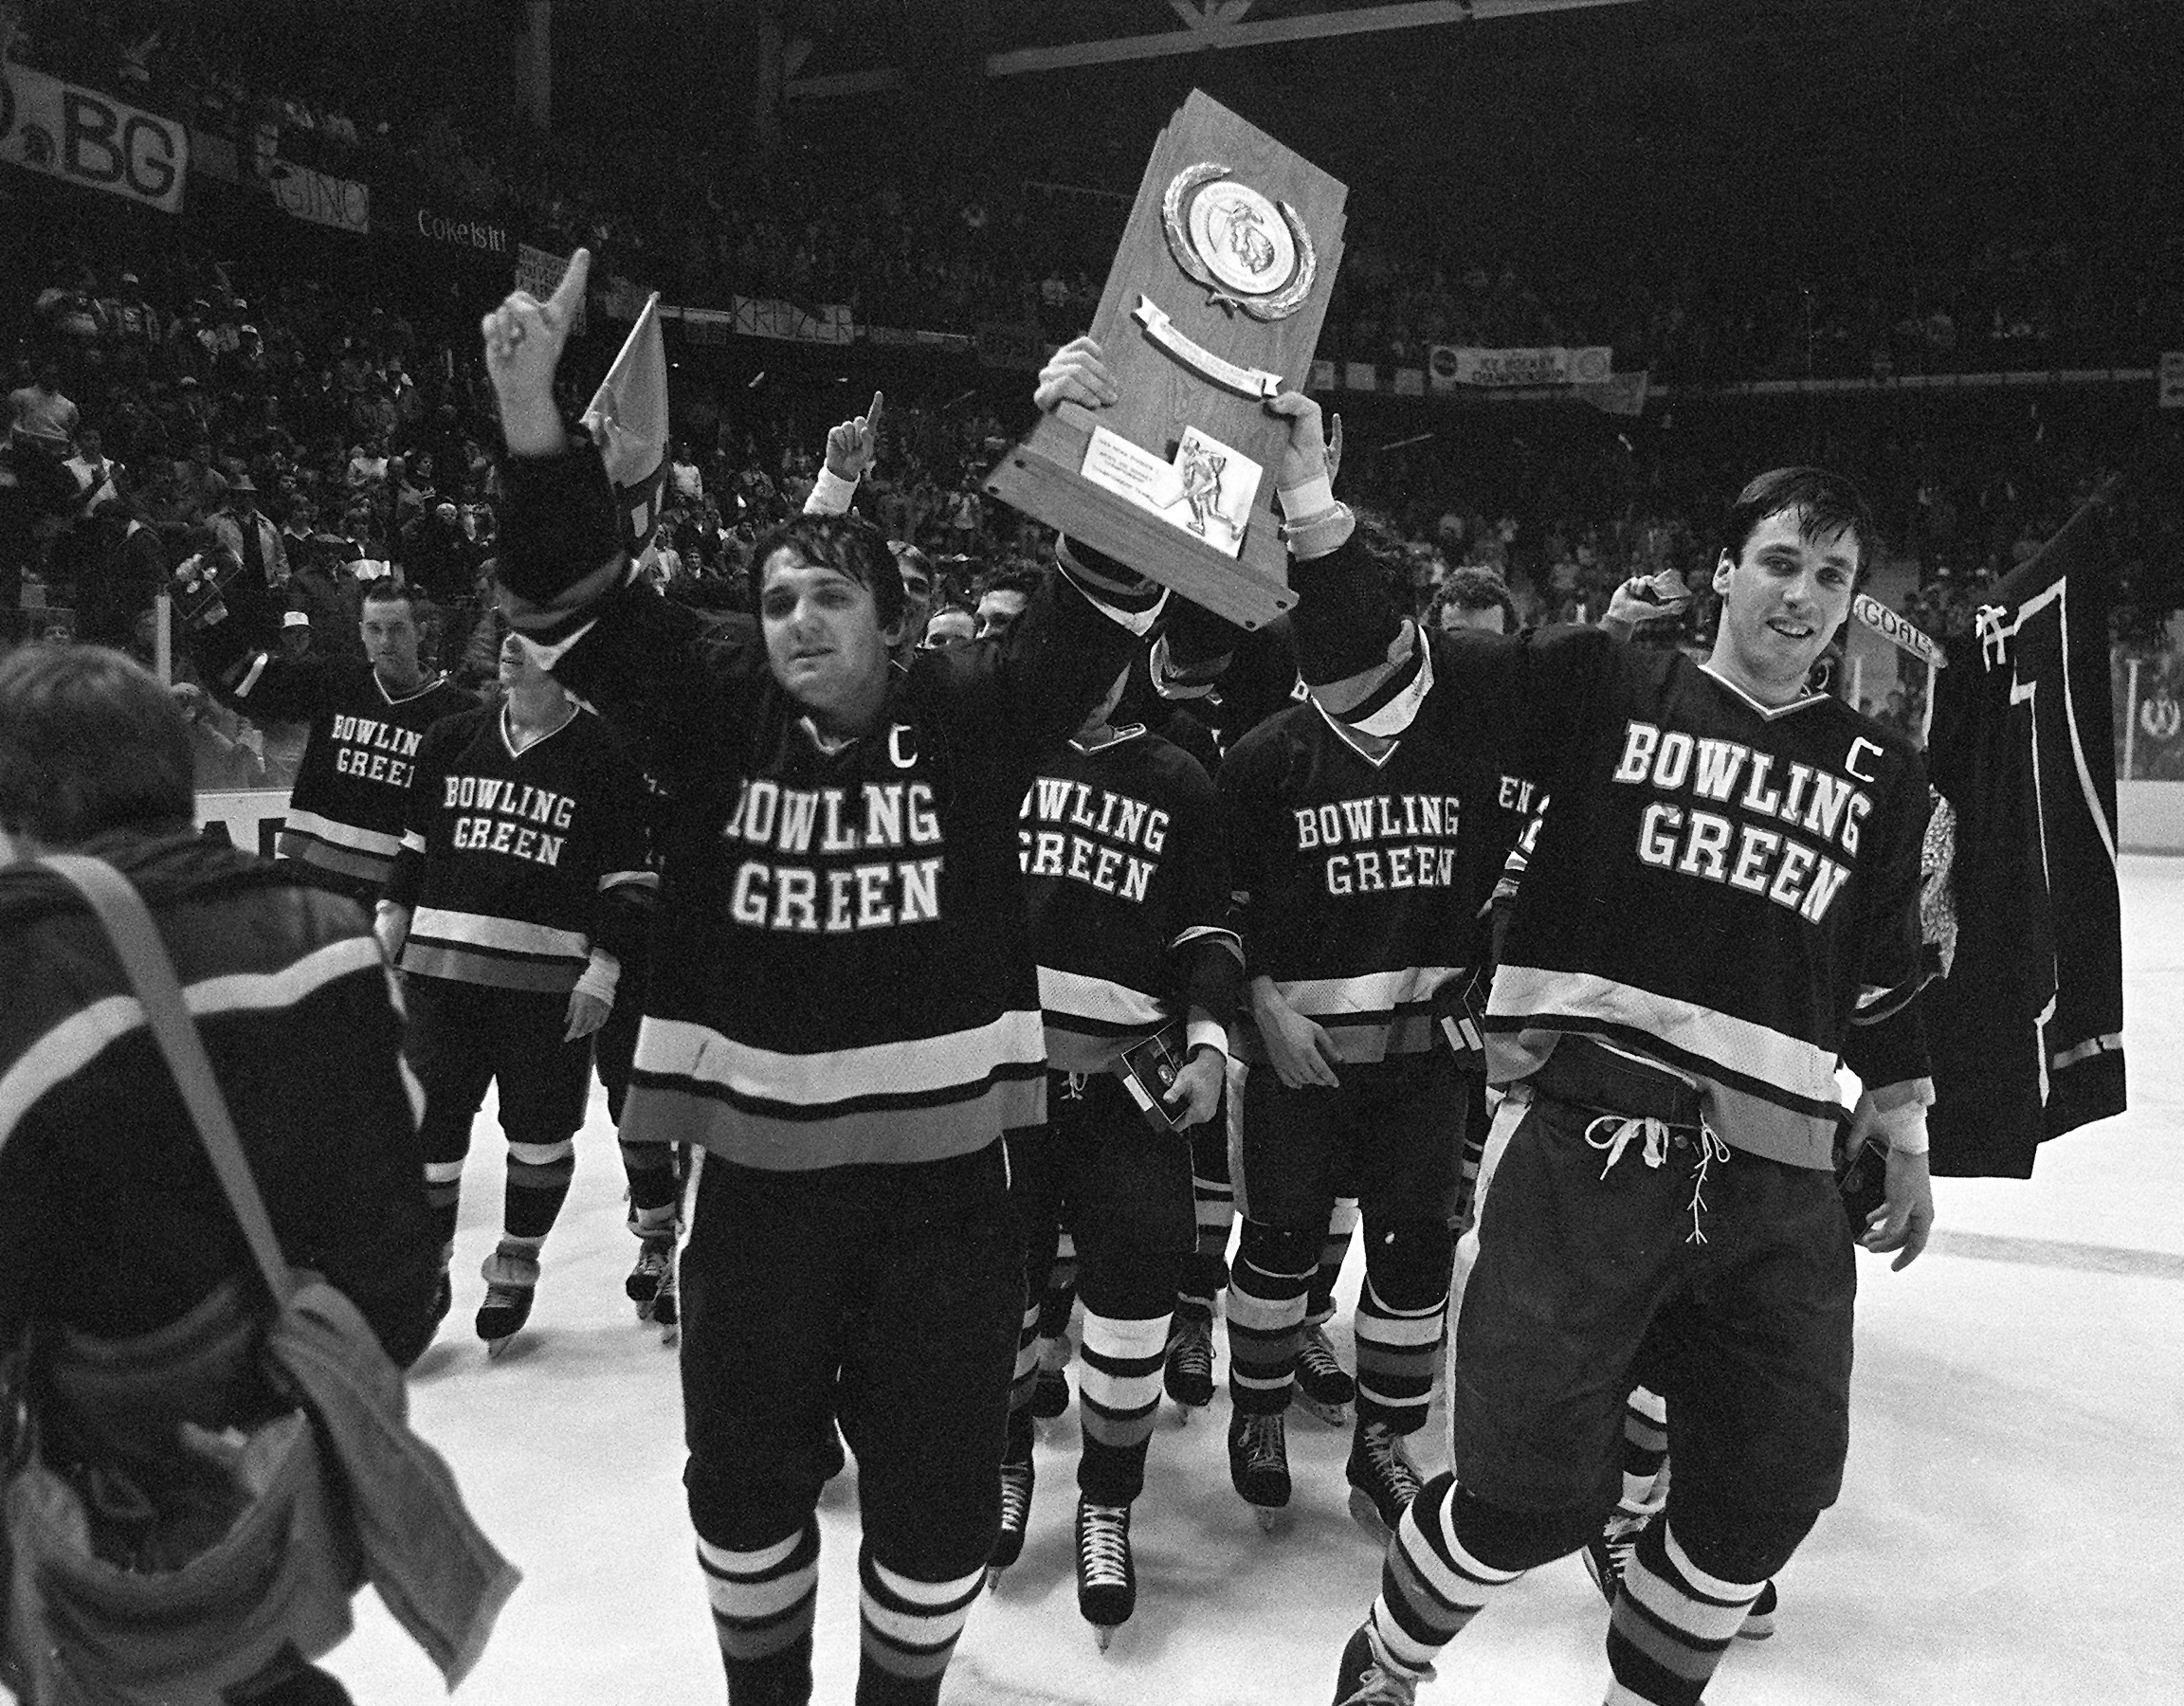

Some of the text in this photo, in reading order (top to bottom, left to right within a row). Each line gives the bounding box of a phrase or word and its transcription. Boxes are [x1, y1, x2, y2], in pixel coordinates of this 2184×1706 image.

[418, 209, 468, 245] Coke
[888, 722, 919, 769] C
[1845, 736, 1884, 782] C
[445, 775, 575, 829] BOWLING
[1018, 776, 1171, 854] WLING
[1612, 718, 1874, 858] BOWLING
[454, 817, 567, 866] GREEN
[1293, 794, 1461, 850] BOWLING
[1326, 844, 1457, 896] GREEN
[1636, 801, 1851, 925] GREEN
[730, 857, 944, 931] GREEN
